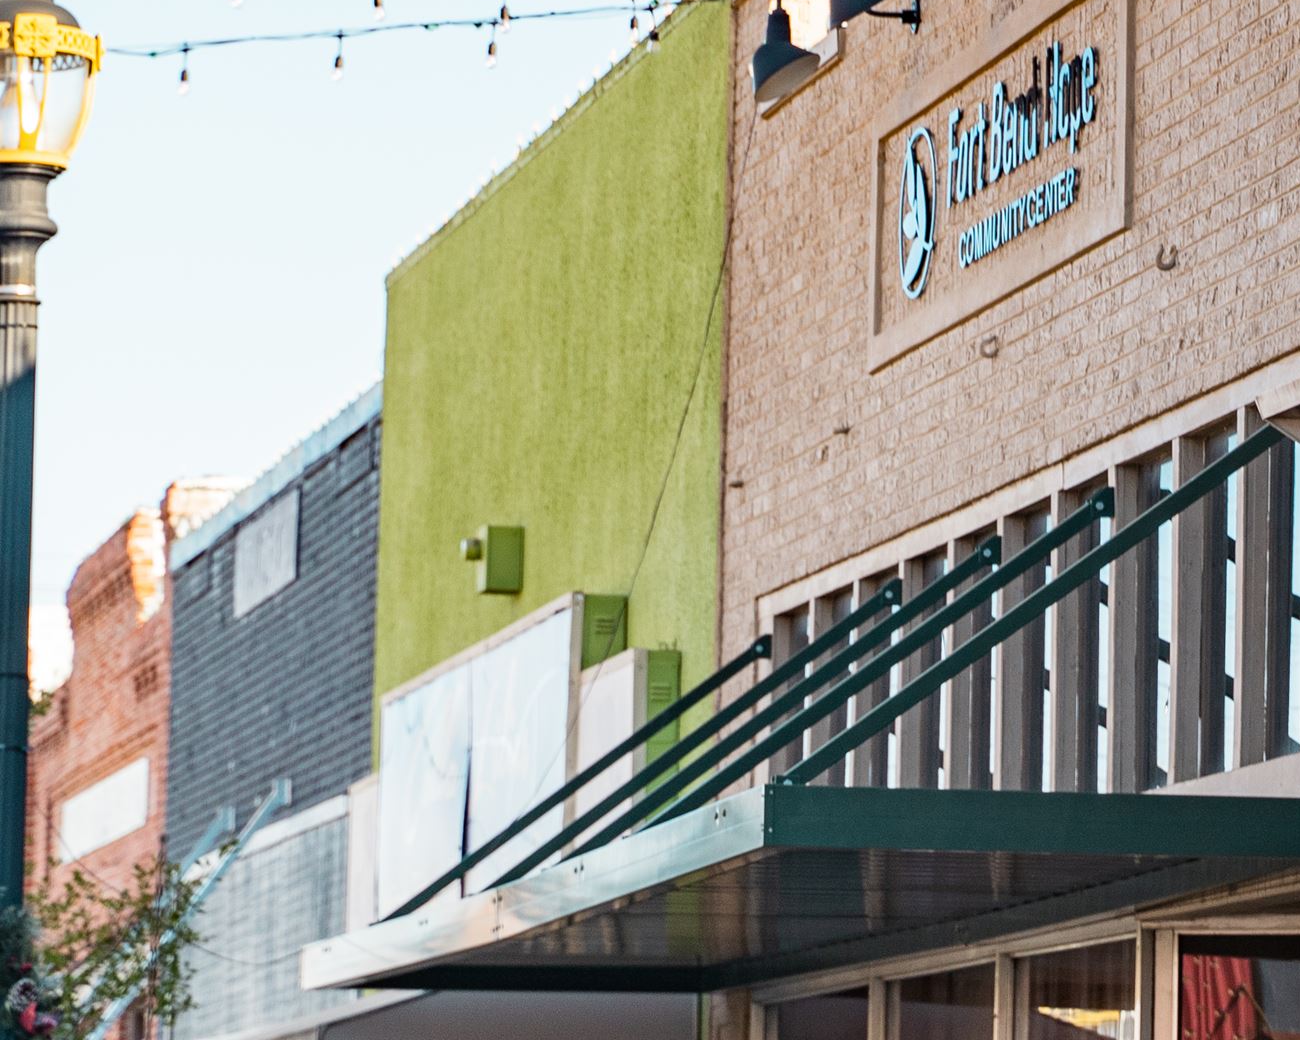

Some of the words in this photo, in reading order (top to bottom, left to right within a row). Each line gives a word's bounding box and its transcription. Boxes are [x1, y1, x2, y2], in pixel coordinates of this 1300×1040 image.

[946, 101, 986, 208] Fort
[989, 56, 1041, 183] Bend
[1043, 40, 1094, 154] Hope
